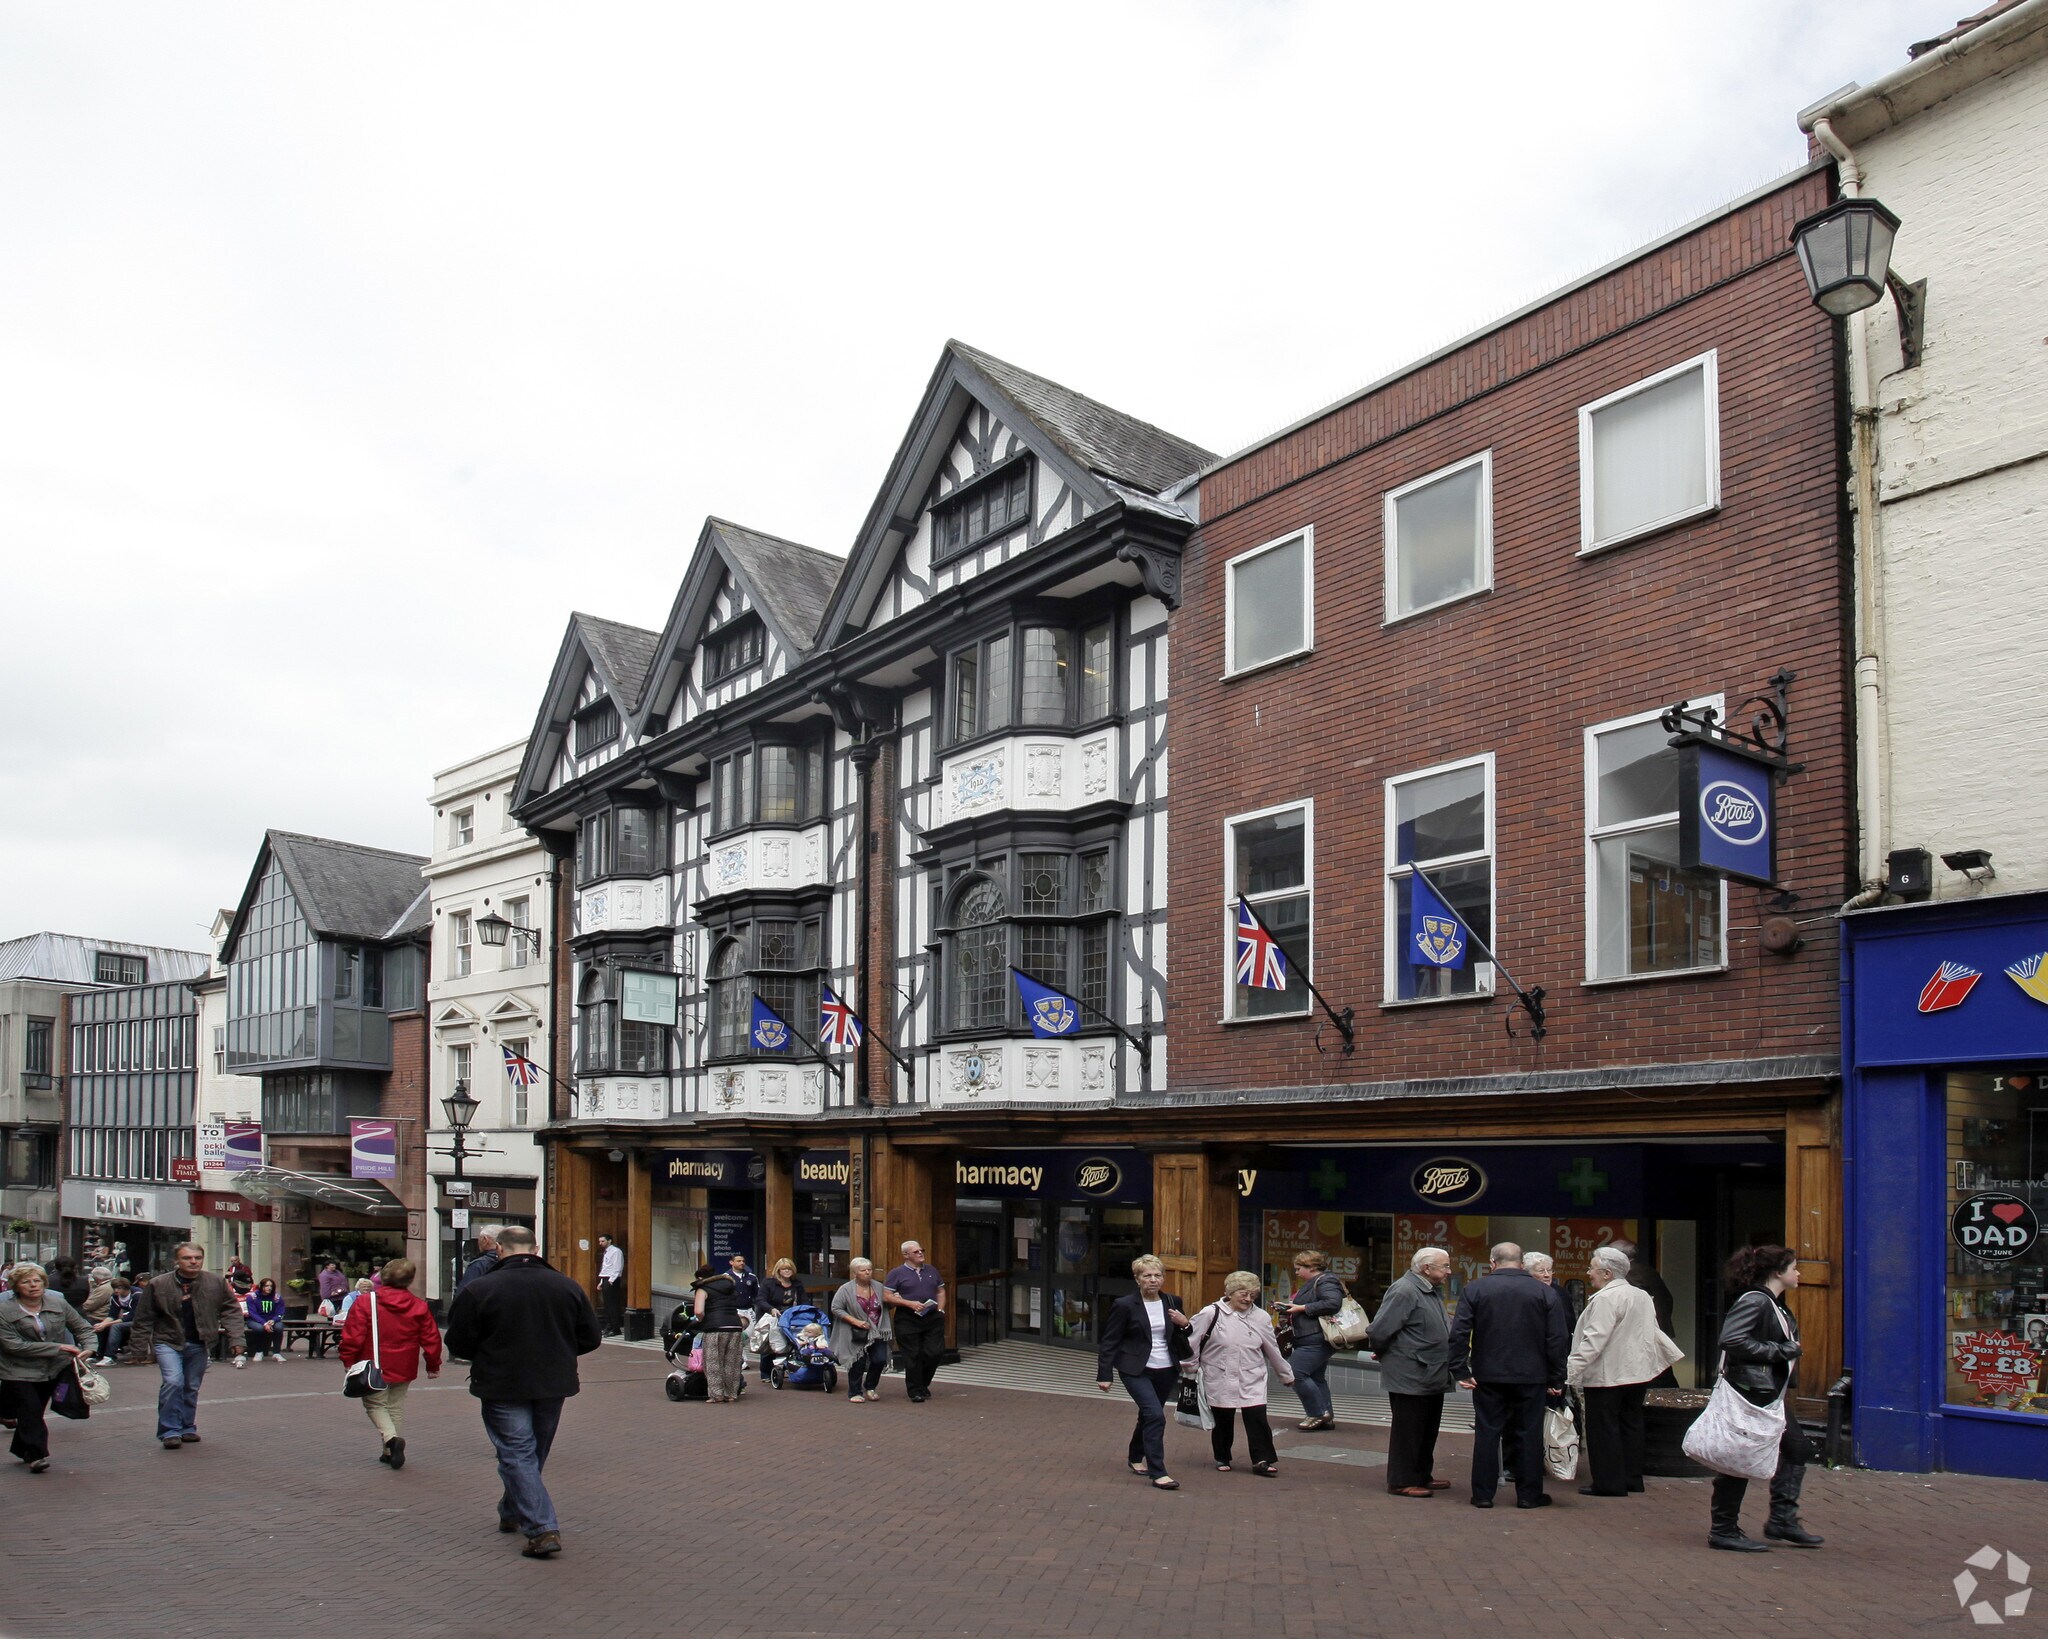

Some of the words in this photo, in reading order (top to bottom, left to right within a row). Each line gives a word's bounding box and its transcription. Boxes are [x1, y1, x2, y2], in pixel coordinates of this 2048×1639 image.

[1711, 793, 1755, 828] Boots
[1901, 874, 1910, 884] 6
[1993, 1076, 2004, 1092] I
[669, 1158, 724, 1181] pharmacy
[801, 1159, 850, 1185] beauty
[1078, 1165, 1110, 1187] Boots
[1238, 1169, 1257, 1197] y
[1419, 1167, 1469, 1194] Boots
[1992, 1179, 2021, 1188] THE
[96, 1195, 145, 1218] BANK
[215, 1201, 225, 1210] PAST
[226, 1202, 240, 1212] TIMES
[1970, 1201, 1985, 1221] I
[713, 1221, 744, 1229] pharmacy
[713, 1227, 734, 1235] beauty
[1268, 1219, 1280, 1238] 3
[1282, 1228, 1296, 1239] for
[1297, 1220, 1310, 1240] 2
[1398, 1219, 1413, 1241] 3
[1414, 1229, 1432, 1241] for
[1434, 1220, 1448, 1242] 2
[1268, 1239, 1281, 1249] Mix
[1283, 1240, 1289, 1249] &
[1290, 1240, 1316, 1250] Match
[1555, 1225, 1571, 1248] 3
[1574, 1236, 1594, 1249] for
[1961, 1225, 2028, 1246] DAD
[1397, 1241, 1414, 1252] Mix
[1555, 1249, 1574, 1260] Mix
[1577, 1250, 1585, 1260] &
[1993, 1249, 2013, 1257] JUNE
[1972, 1346, 1994, 1355] Box
[1997, 1347, 2022, 1357] Sets
[1985, 1338, 2010, 1347] DVD
[1961, 1353, 1978, 1371] 2
[1995, 1357, 2032, 1375] £8
